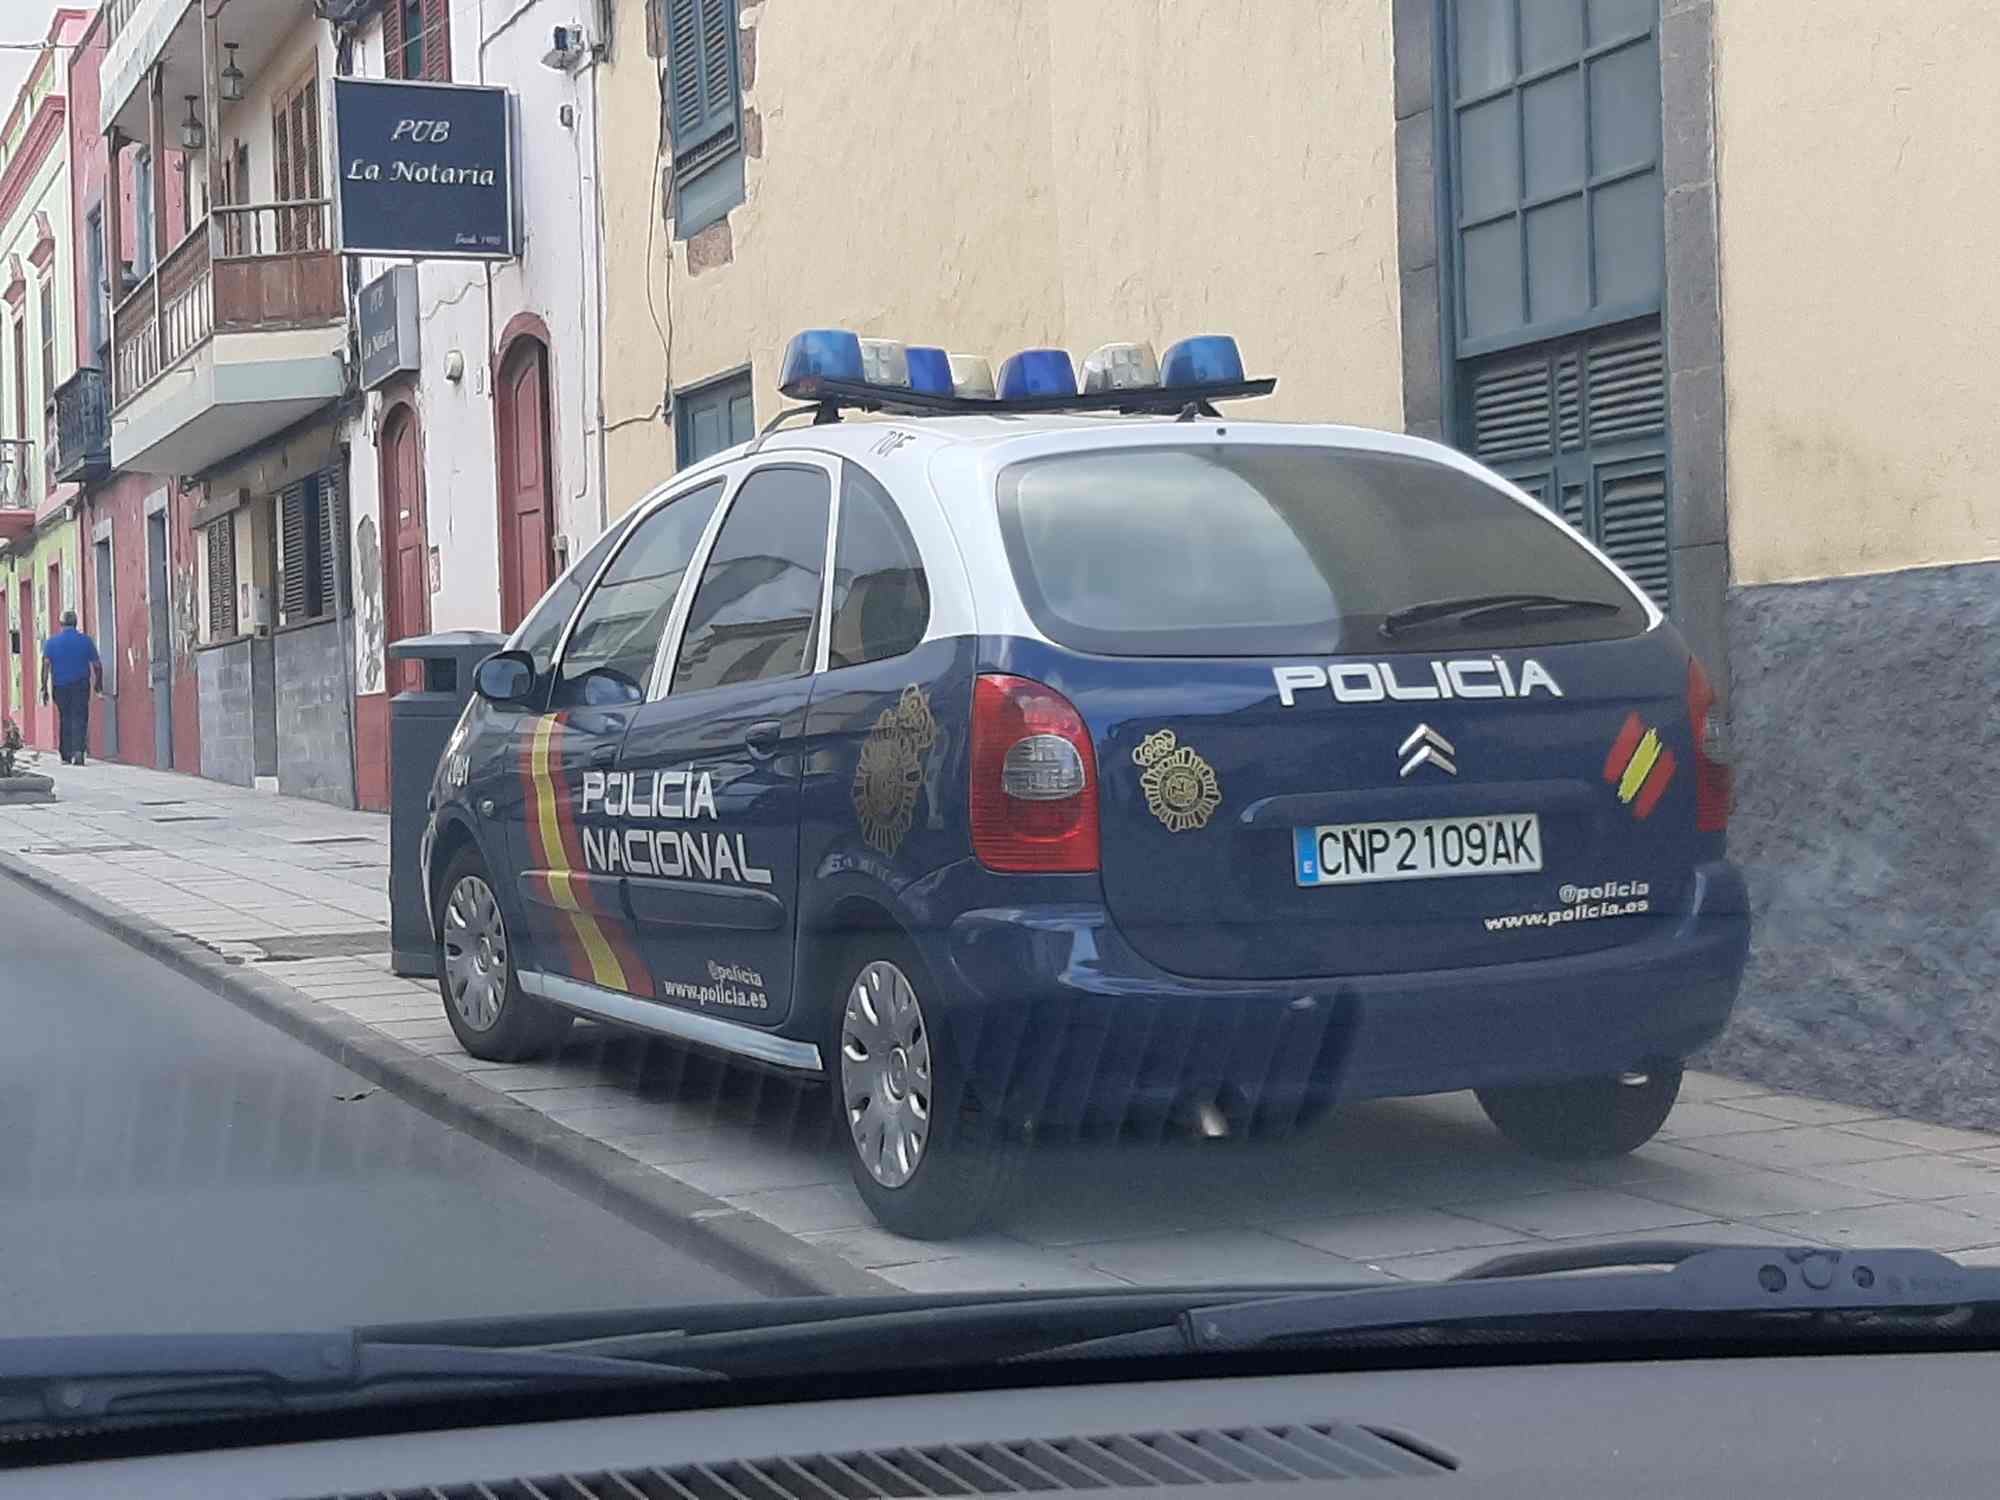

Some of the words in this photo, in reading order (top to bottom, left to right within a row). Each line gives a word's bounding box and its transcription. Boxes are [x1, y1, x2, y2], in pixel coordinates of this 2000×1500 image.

[390, 119, 450, 143] PUB
[347, 158, 380, 181] La
[389, 161, 495, 186] Notaria
[1272, 656, 1563, 706] POLICÍA
[582, 762, 718, 820] POLICÍA
[583, 827, 772, 884] NACIONAL
[1303, 860, 1313, 874] E
[1559, 881, 1649, 903] @policia
[1485, 900, 1649, 930] www.policia.es
[663, 980, 768, 1009] www.policia.es
